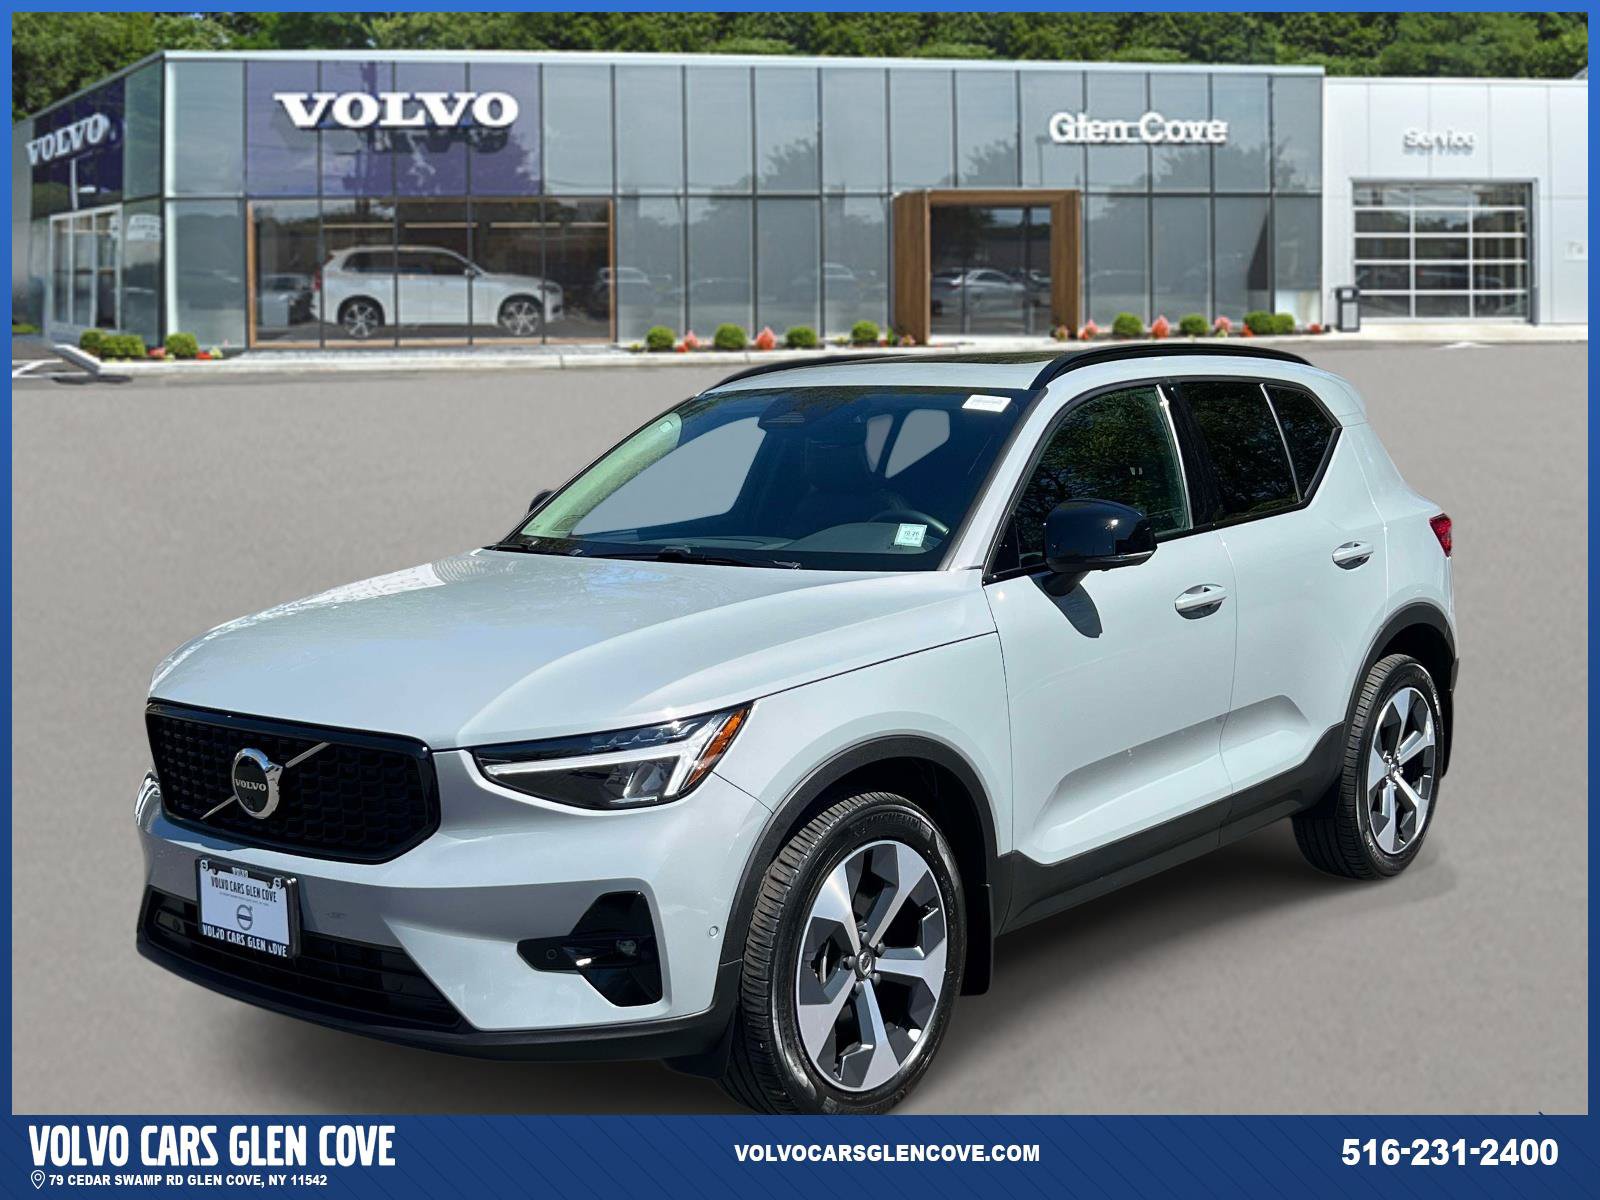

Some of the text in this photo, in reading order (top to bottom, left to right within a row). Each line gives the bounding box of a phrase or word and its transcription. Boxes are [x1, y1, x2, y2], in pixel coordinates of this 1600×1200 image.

[273, 92, 519, 127] VOLVO
[24, 112, 111, 166] VOLVO
[1049, 111, 1229, 144] Glen Cove
[1402, 127, 1475, 153] Service
[234, 778, 267, 792] VOLVO
[210, 876, 229, 890] VOLVO
[229, 881, 245, 895] CARS
[246, 884, 261, 899] GLEN
[262, 888, 278, 903] COVE
[226, 930, 246, 946] CARS
[247, 936, 267, 951] GLEN
